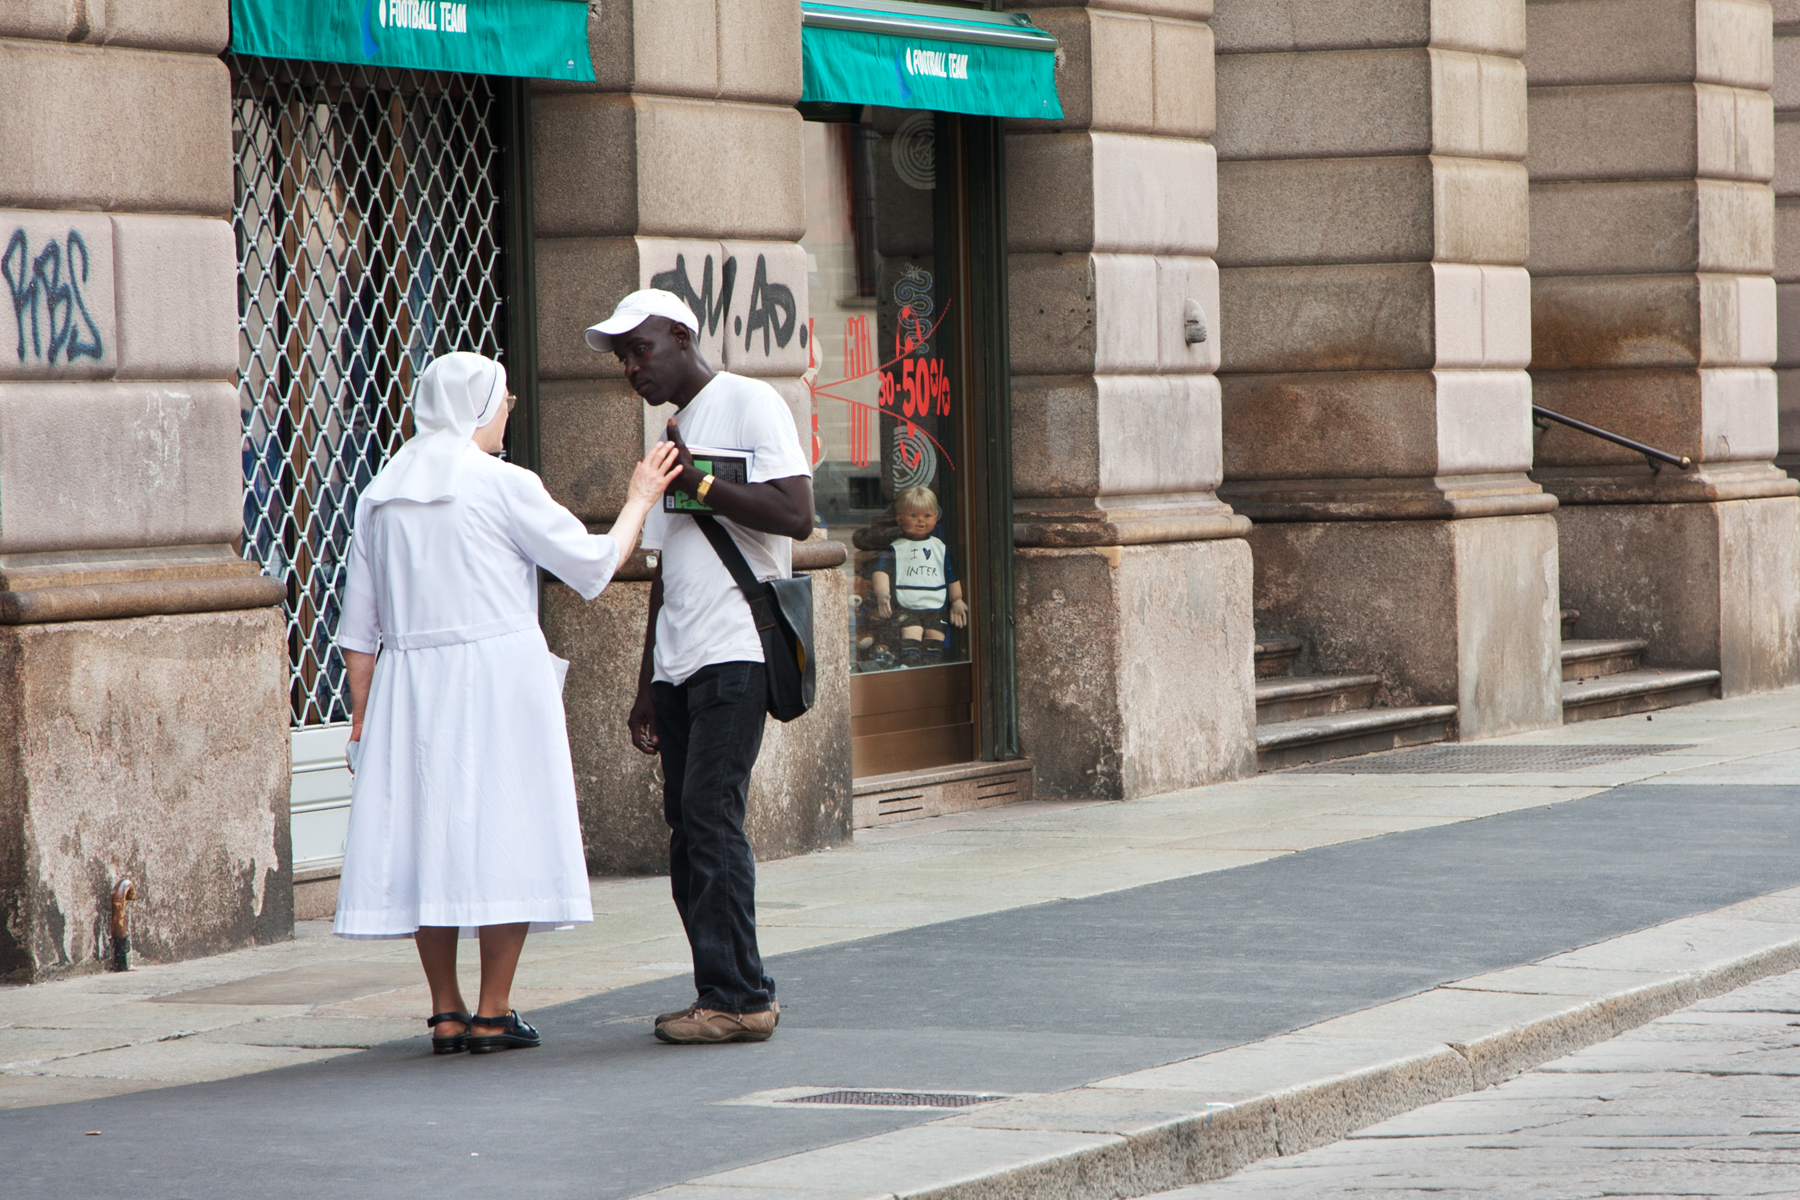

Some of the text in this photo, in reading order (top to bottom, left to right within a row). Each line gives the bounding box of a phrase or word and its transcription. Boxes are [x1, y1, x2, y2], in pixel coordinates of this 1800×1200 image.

[390, 0, 467, 33] FOOTBALL TEAM
[913, 49, 968, 79] FOOTBALL TEAM
[910, 548, 919, 560] I
[906, 565, 938, 577] INTER
